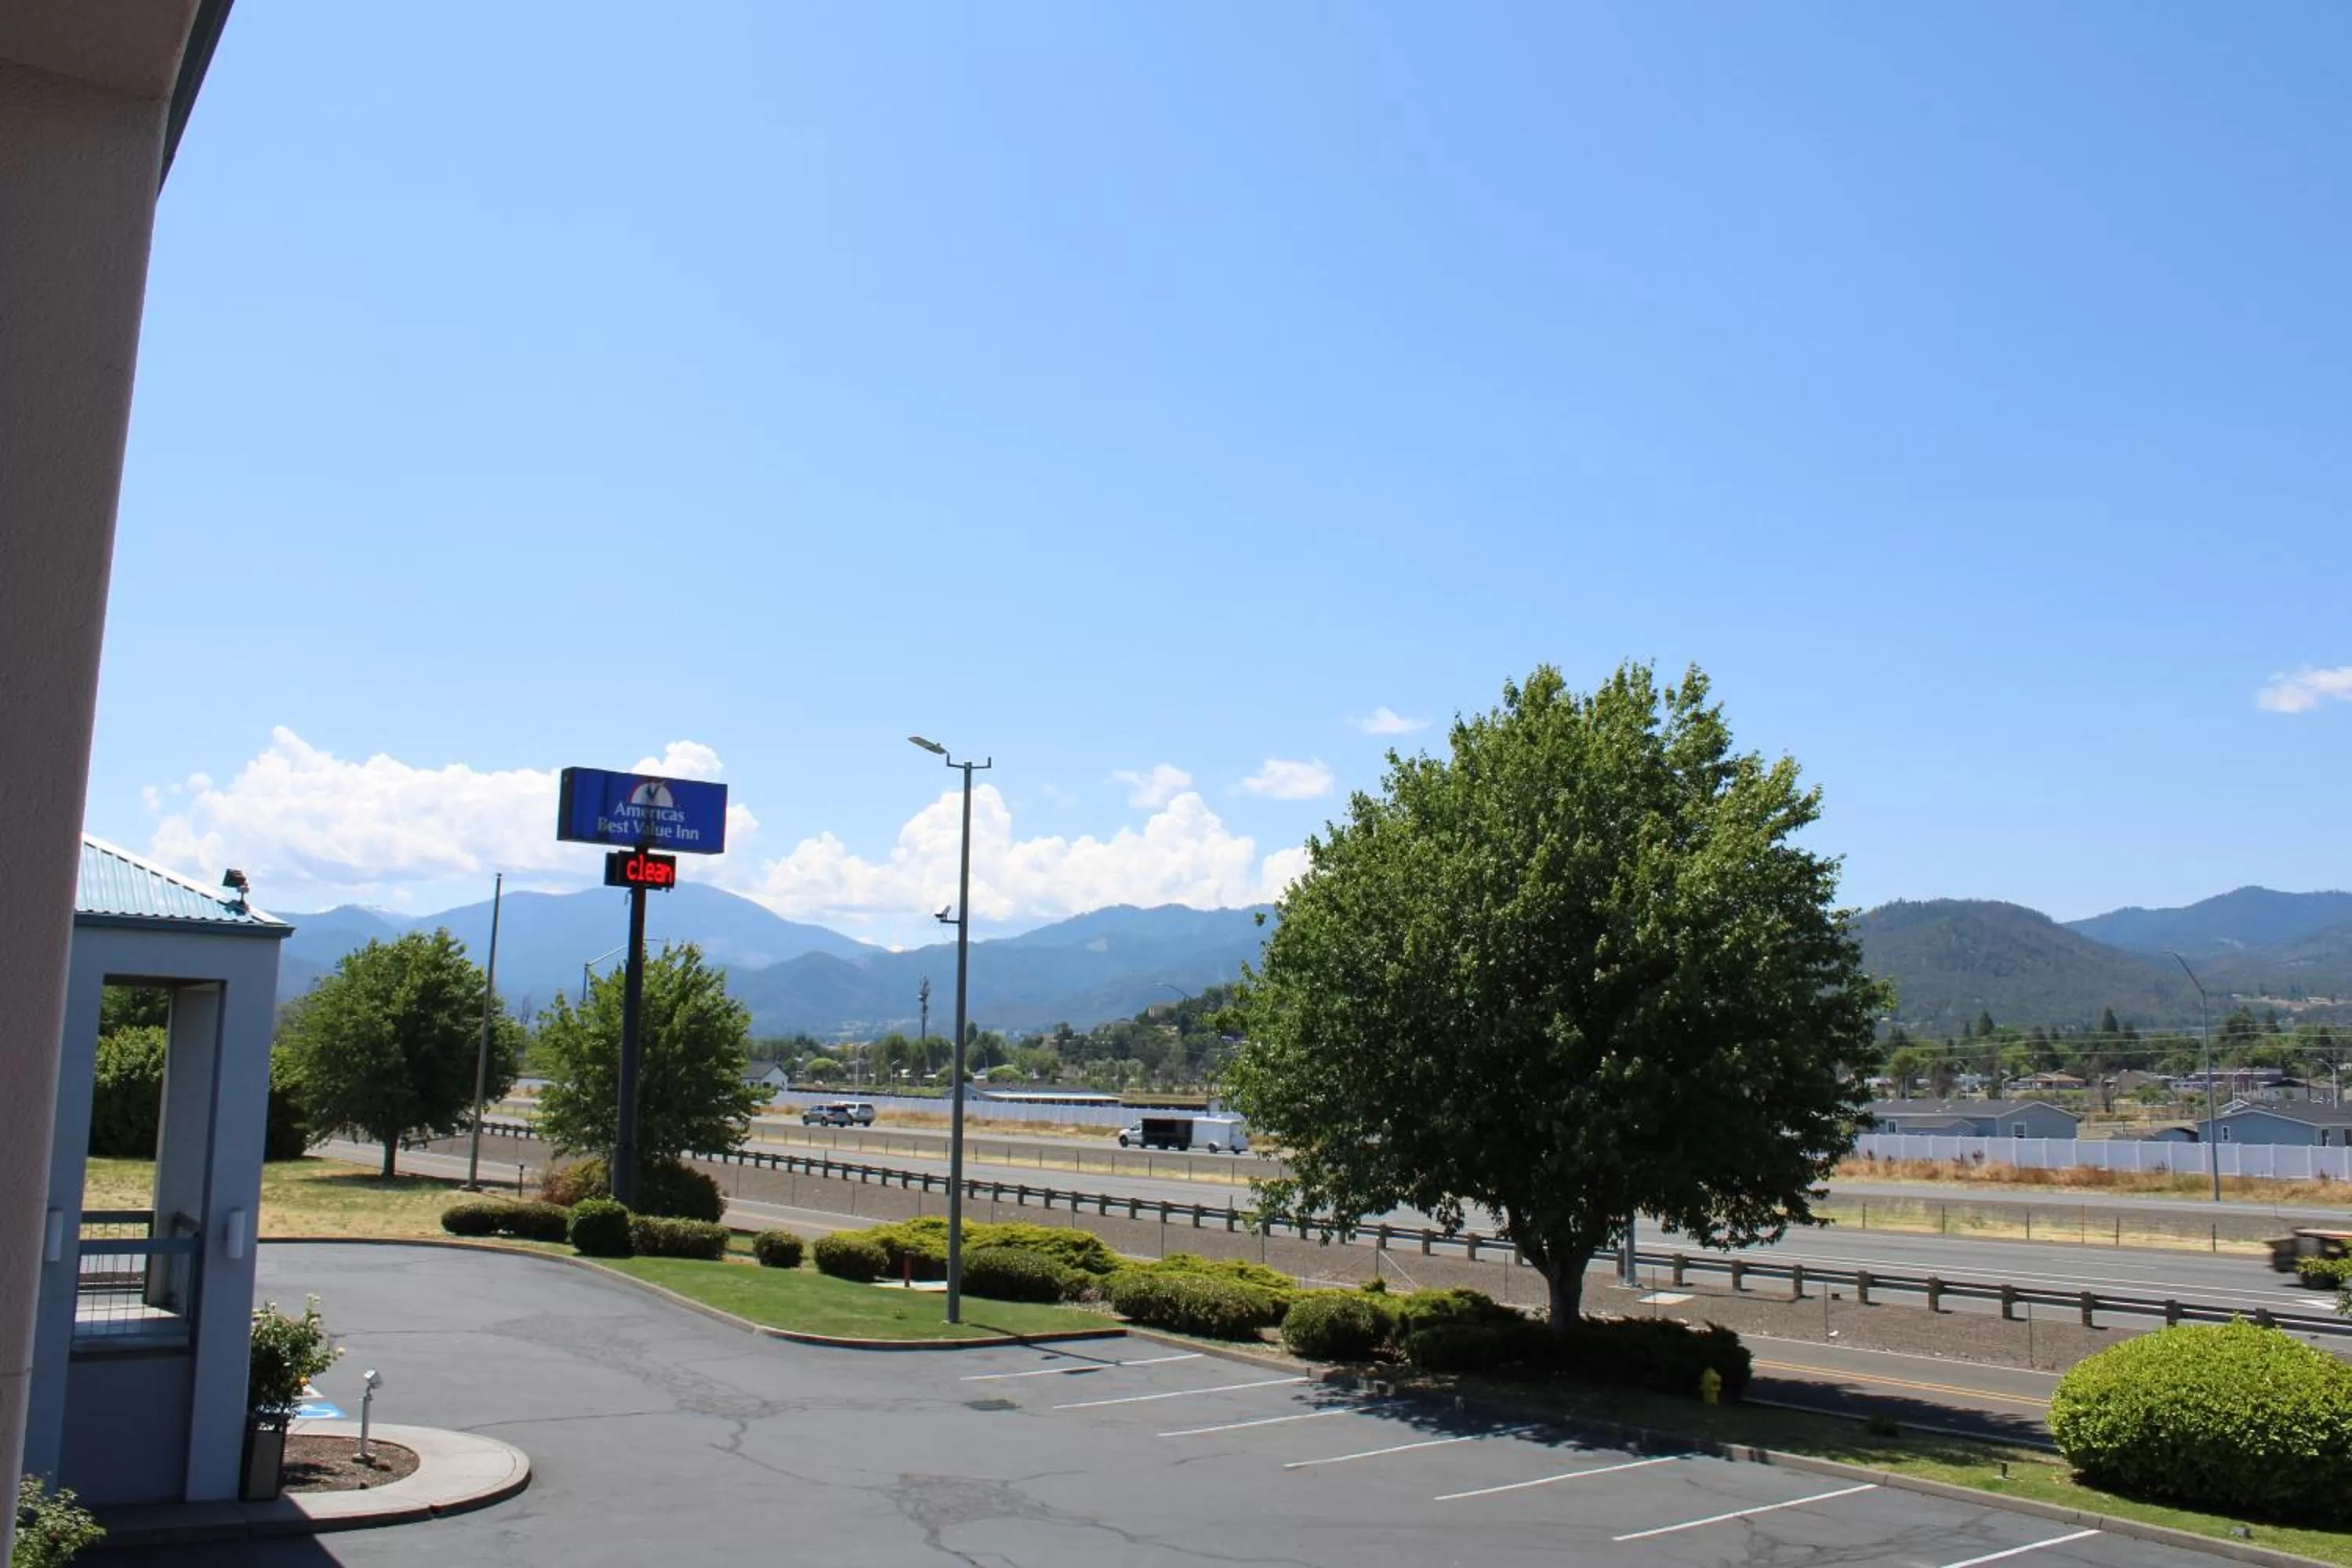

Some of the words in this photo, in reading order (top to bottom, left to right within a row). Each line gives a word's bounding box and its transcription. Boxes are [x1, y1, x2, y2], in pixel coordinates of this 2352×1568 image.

[614, 802, 685, 822] Americas
[597, 816, 630, 833] Best
[633, 822, 673, 838] Value
[676, 825, 700, 840] Inn
[626, 853, 673, 884] clean
